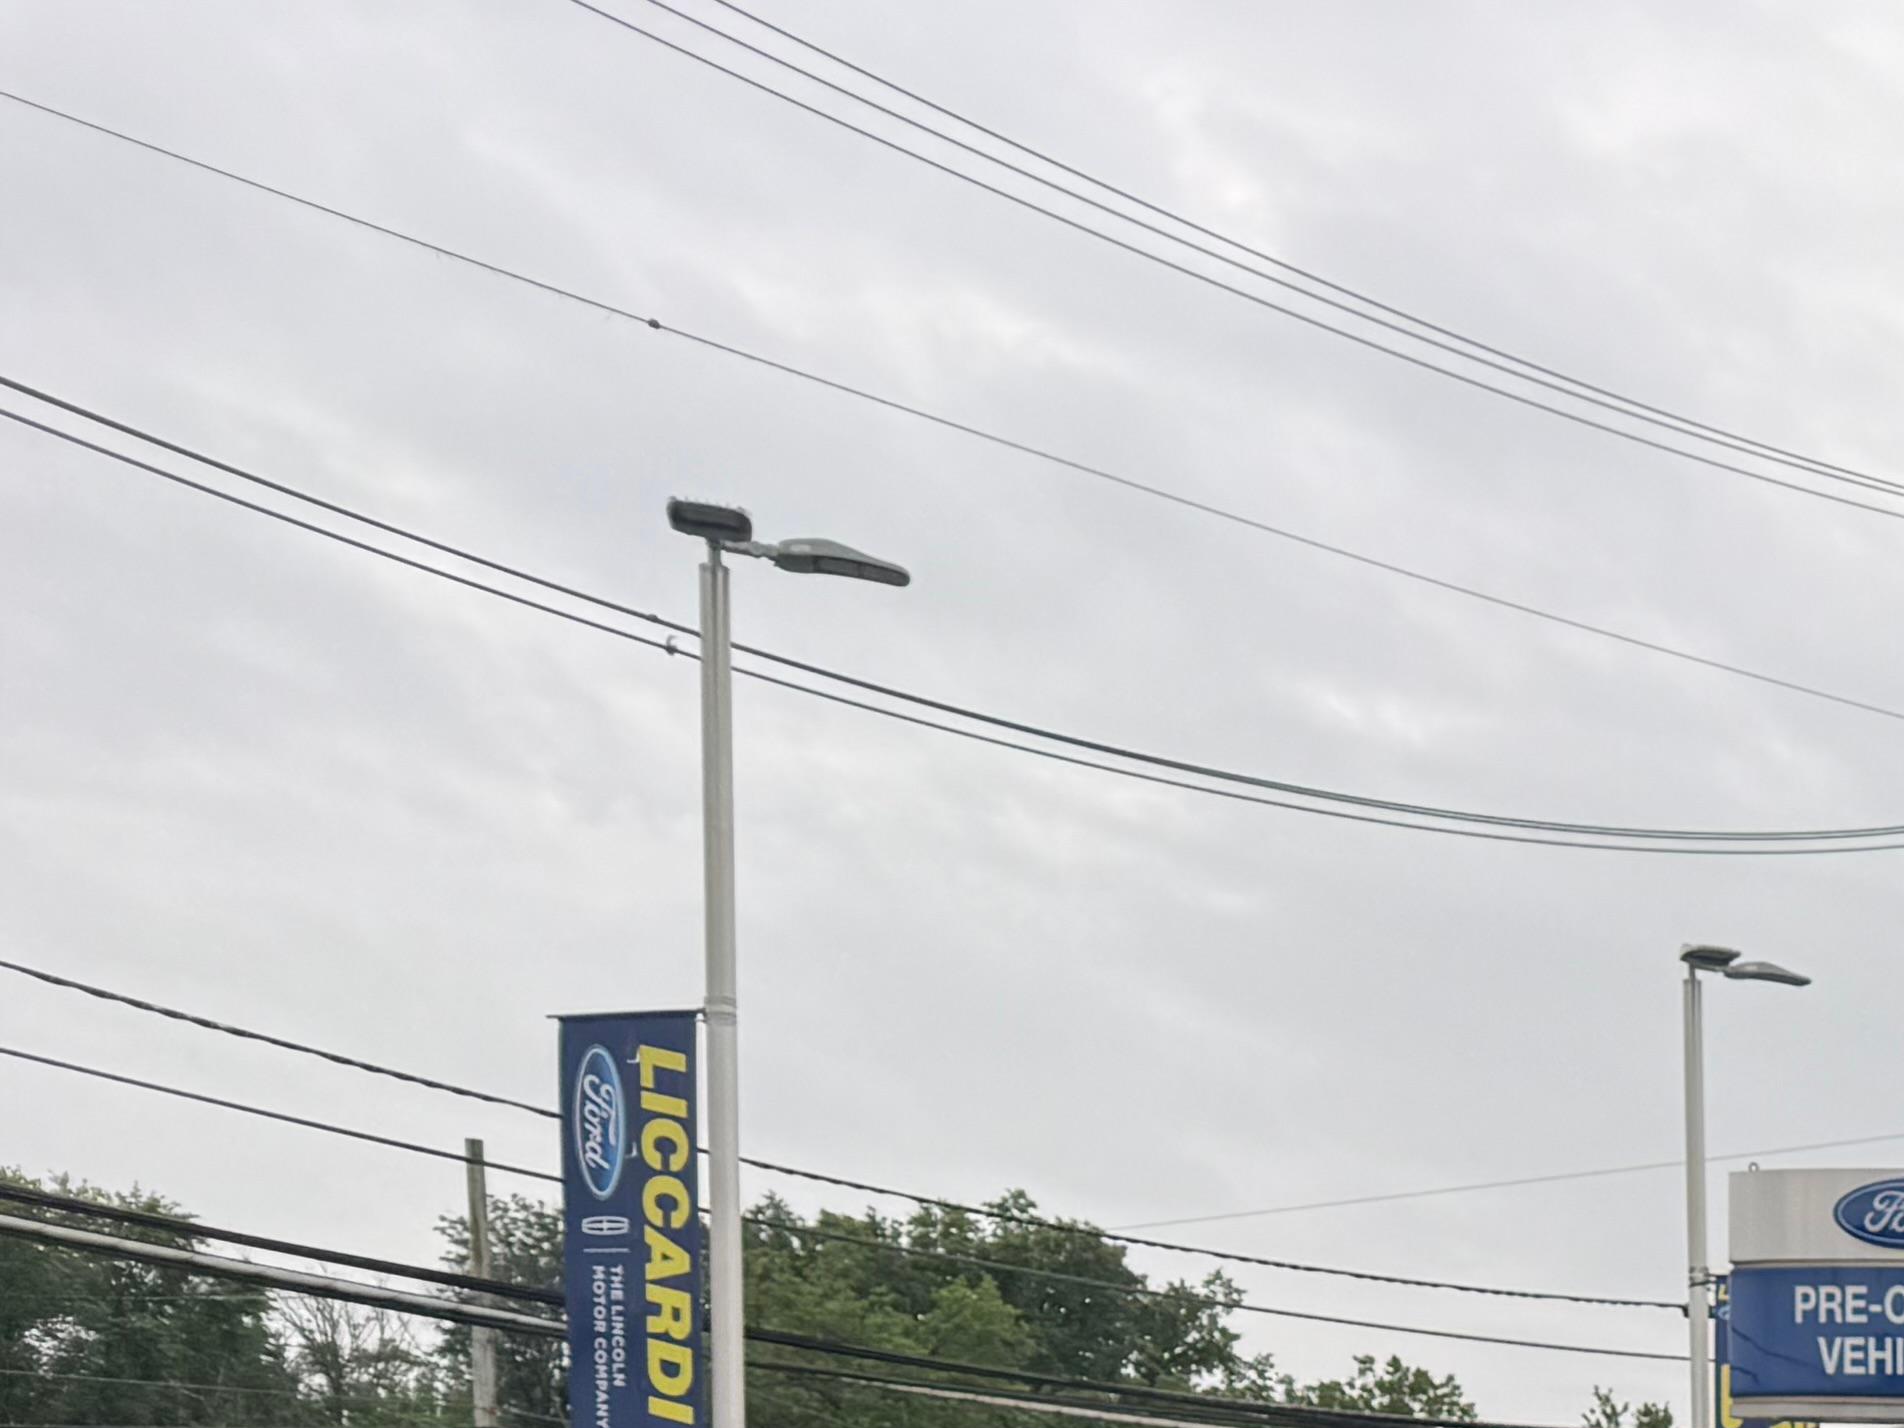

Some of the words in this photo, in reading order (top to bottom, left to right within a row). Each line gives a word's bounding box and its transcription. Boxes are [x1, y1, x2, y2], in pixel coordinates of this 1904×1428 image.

[583, 1074, 617, 1169] Ford
[637, 1043, 695, 1426] LICCARDI
[592, 1265, 608, 1333] MOTOR
[610, 1264, 626, 1302] THE
[611, 1304, 626, 1388] LINCOLN
